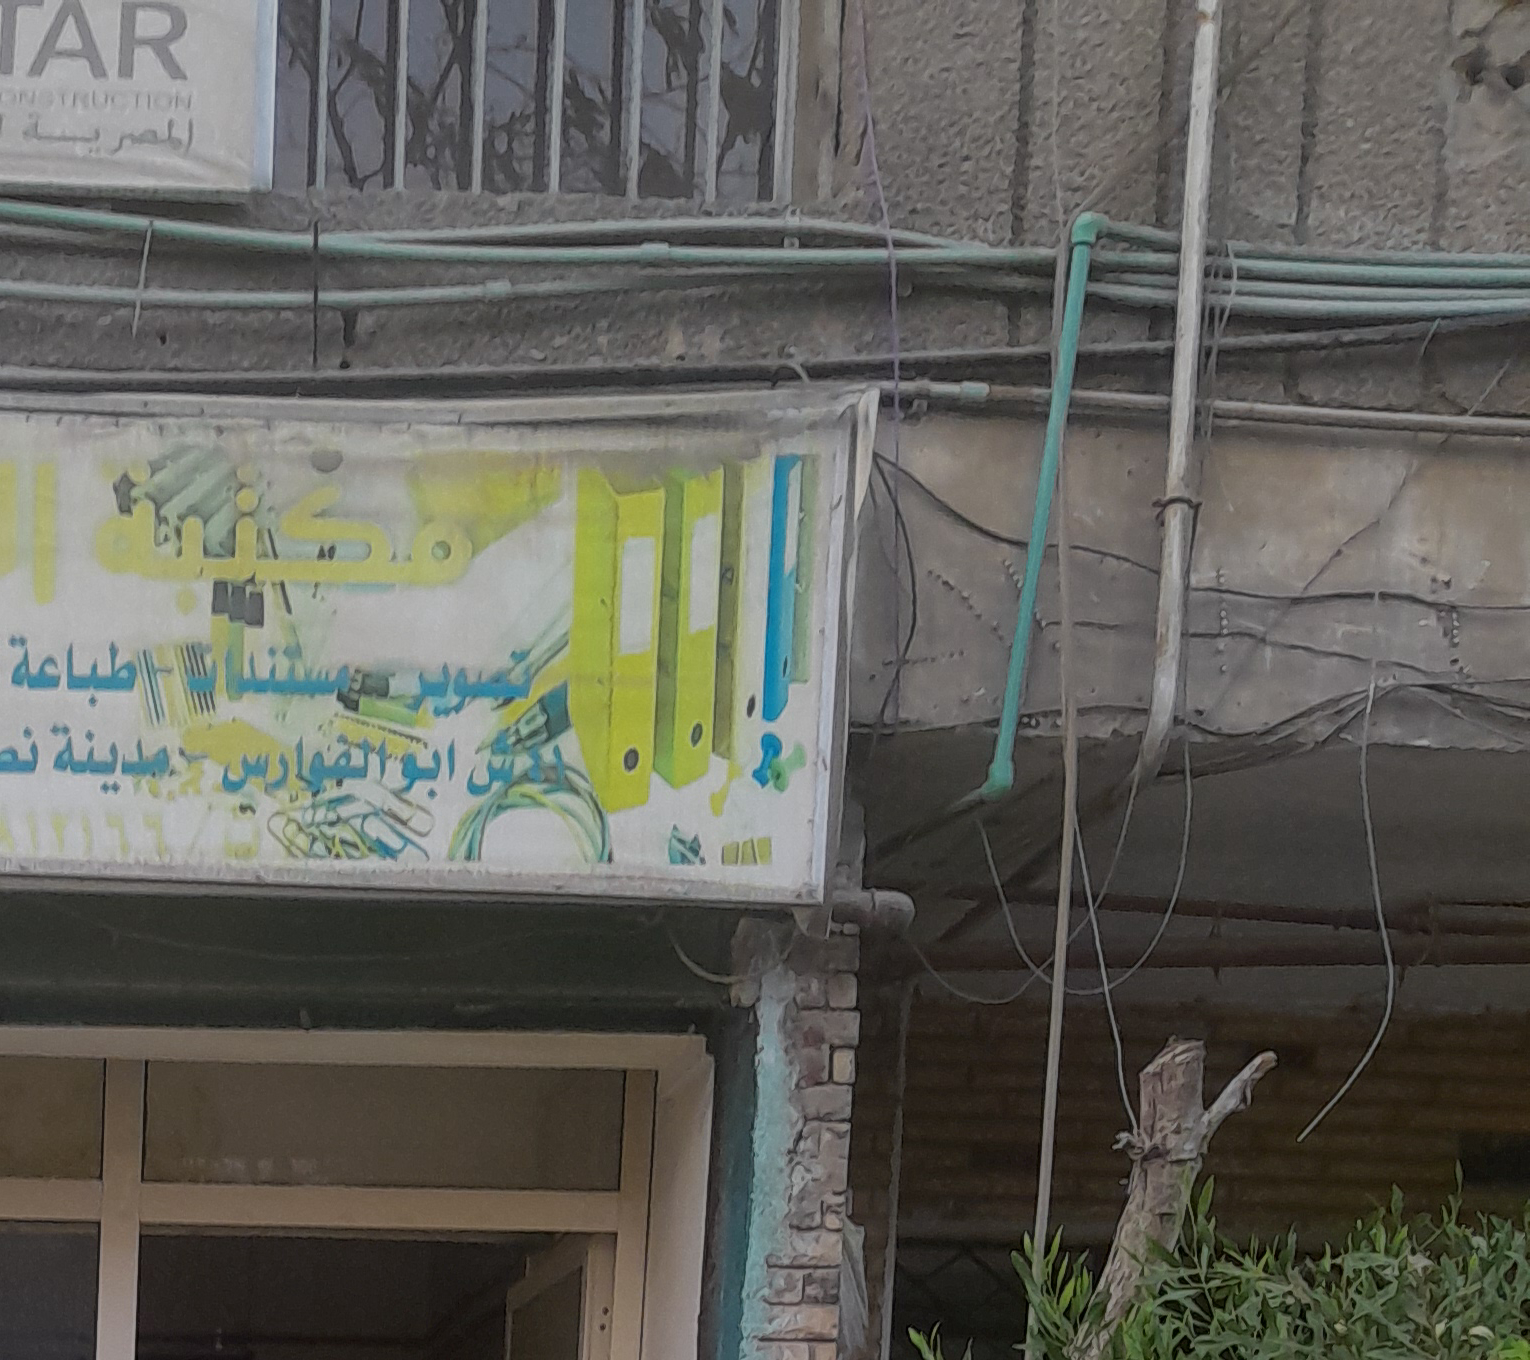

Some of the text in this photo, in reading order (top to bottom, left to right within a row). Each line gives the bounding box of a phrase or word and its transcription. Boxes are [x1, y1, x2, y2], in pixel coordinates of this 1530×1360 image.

[94, 462, 471, 615] مكتبة
[8, 635, 137, 707] طباعة
[406, 648, 531, 718] تصوير
[53, 722, 170, 796] مدينة
